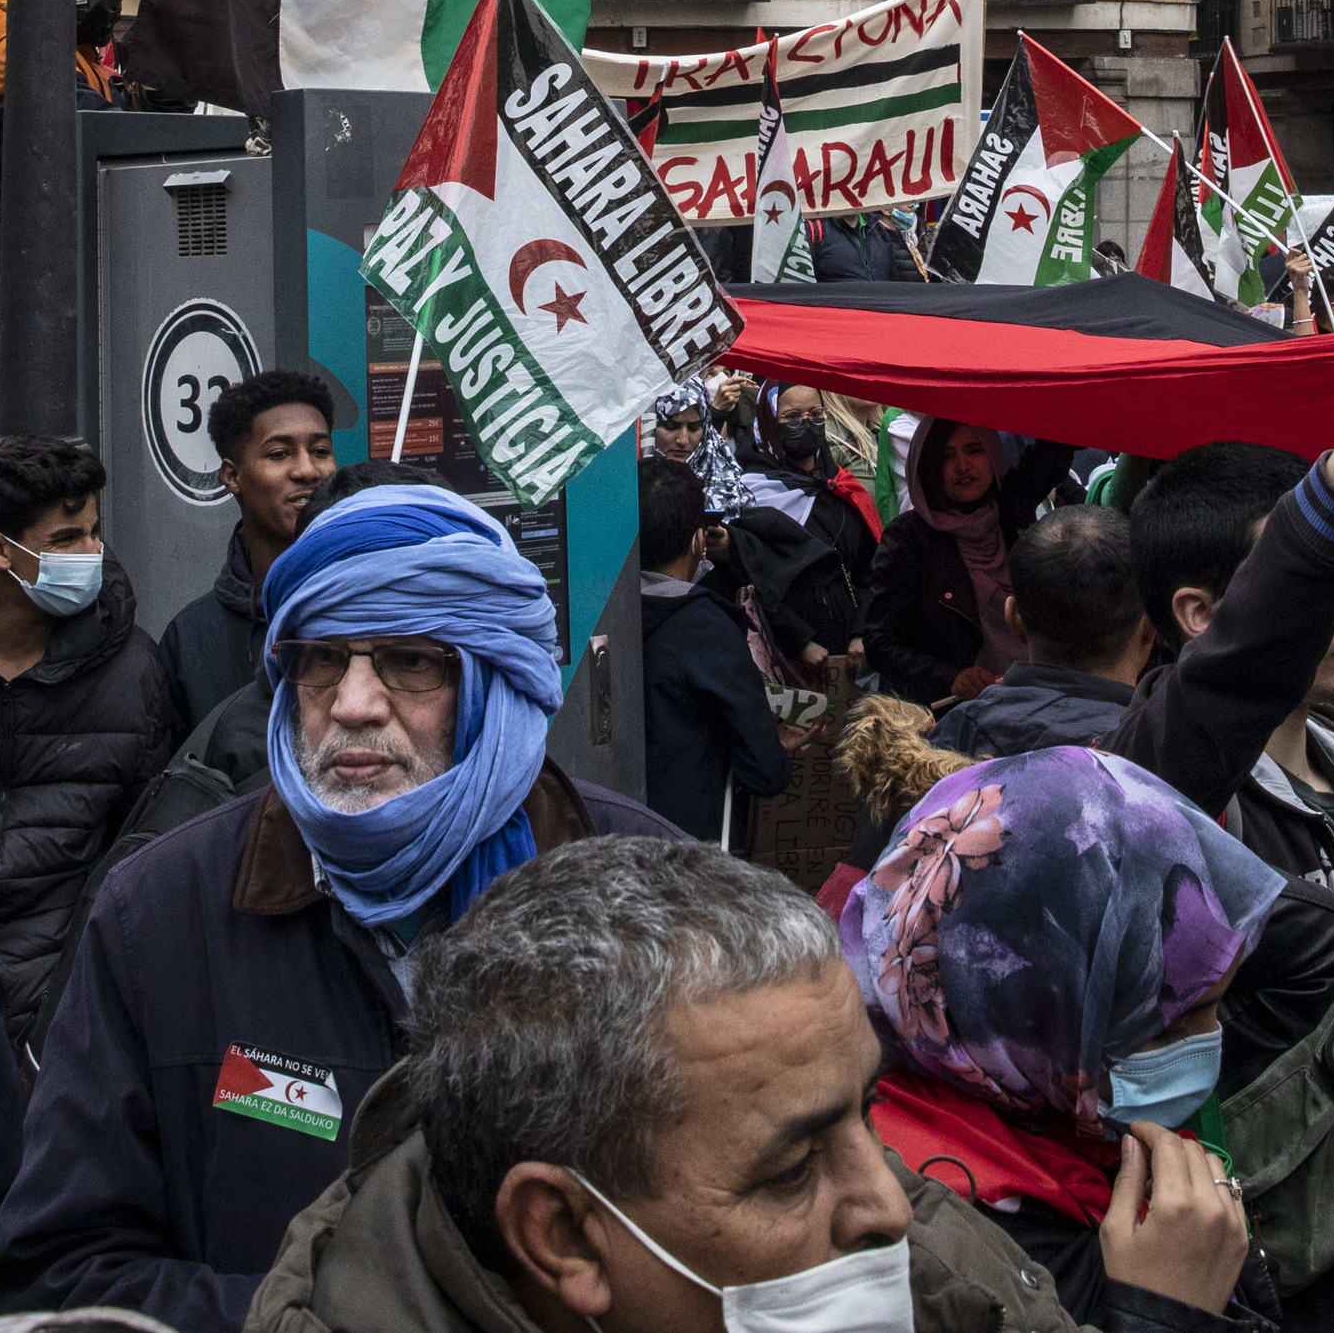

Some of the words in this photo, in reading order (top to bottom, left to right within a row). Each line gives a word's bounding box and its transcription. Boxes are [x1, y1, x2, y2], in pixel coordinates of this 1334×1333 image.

[362, 189, 454, 297] PAZ
[504, 62, 658, 250] SAHARA
[612, 221, 733, 370] LIBRE
[413, 249, 475, 314] Y
[434, 297, 588, 506] JUSTICIA
[230, 1044, 243, 1057] EL
[242, 1047, 283, 1068] SÁHARA
[285, 1059, 301, 1073] NO
[300, 1063, 312, 1076] SE
[218, 1088, 259, 1109] SAHARA
[260, 1100, 272, 1113] EZ
[273, 1103, 288, 1119] DA
[288, 1107, 335, 1131] SALDUKO
